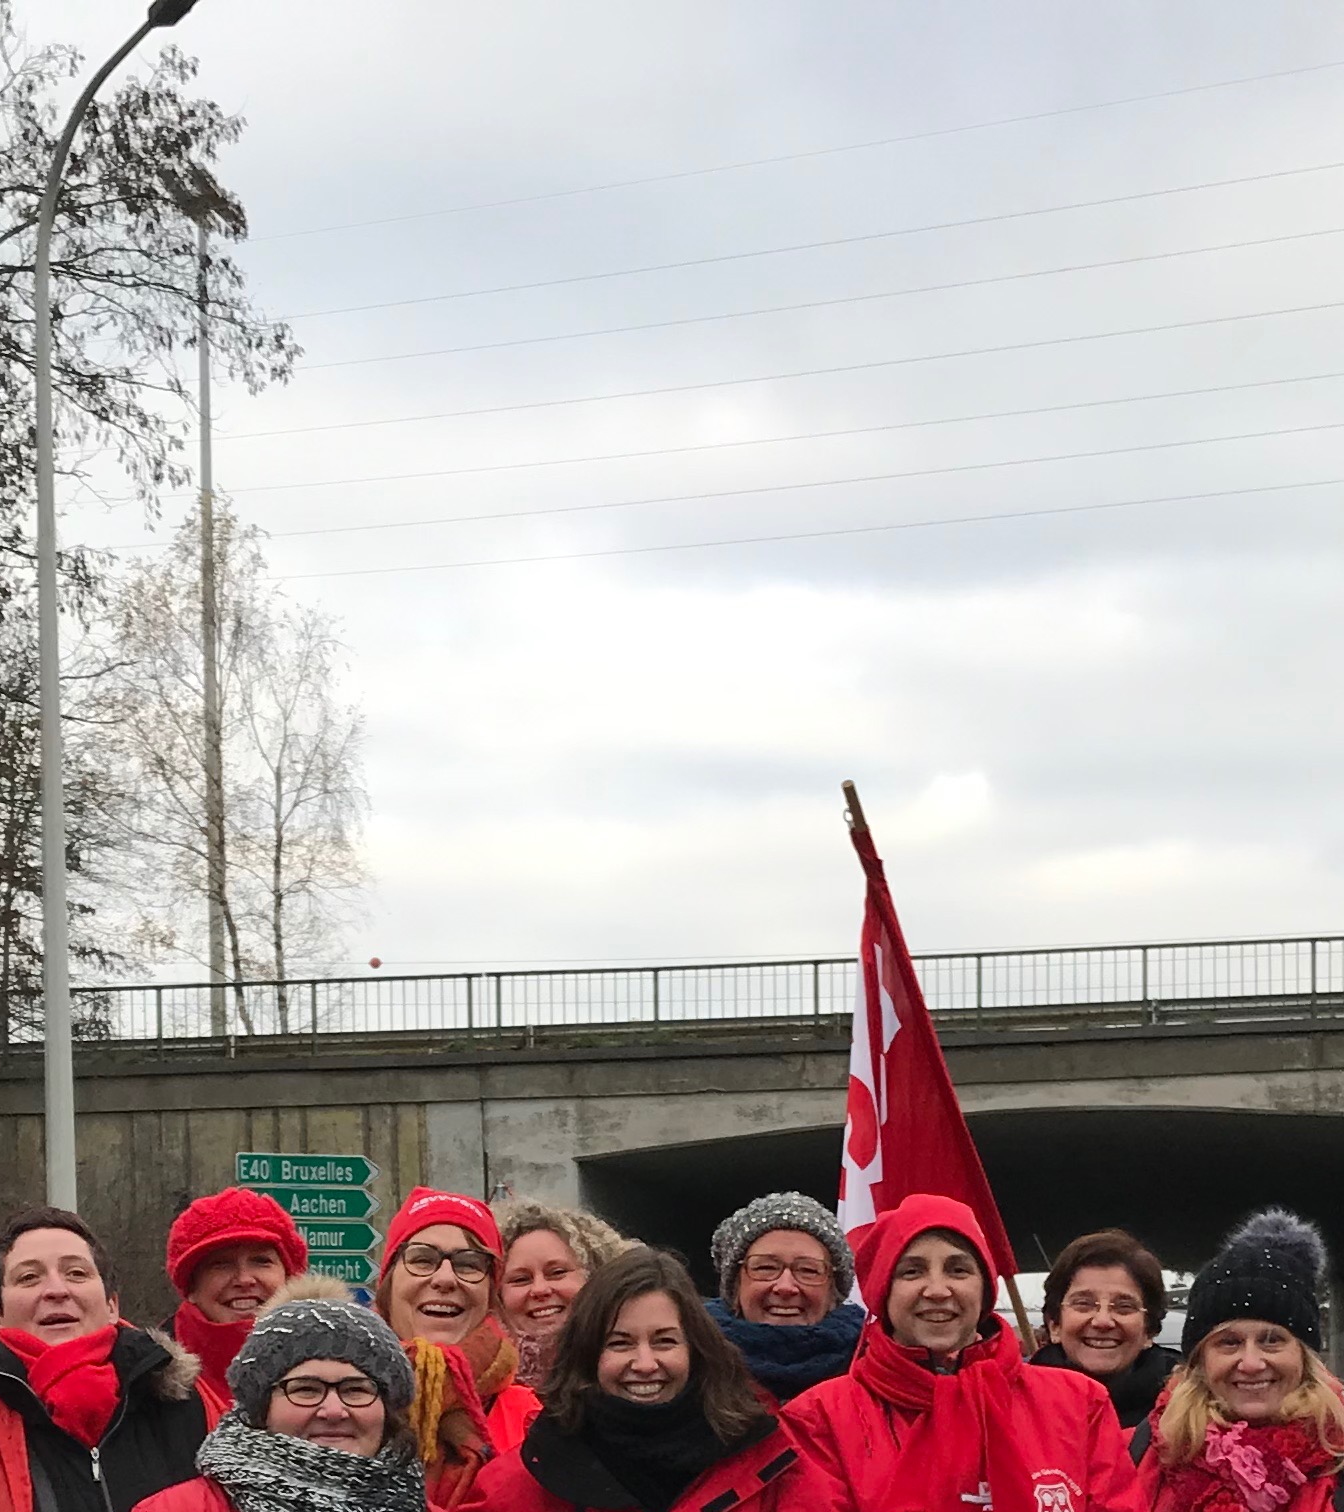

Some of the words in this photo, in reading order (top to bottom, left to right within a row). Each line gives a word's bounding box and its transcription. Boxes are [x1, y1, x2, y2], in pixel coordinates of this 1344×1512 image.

[239, 1158, 270, 1181] E40
[281, 1160, 354, 1182] Bruxelles
[289, 1193, 347, 1215] Aachen
[308, 1259, 361, 1280] stricht
